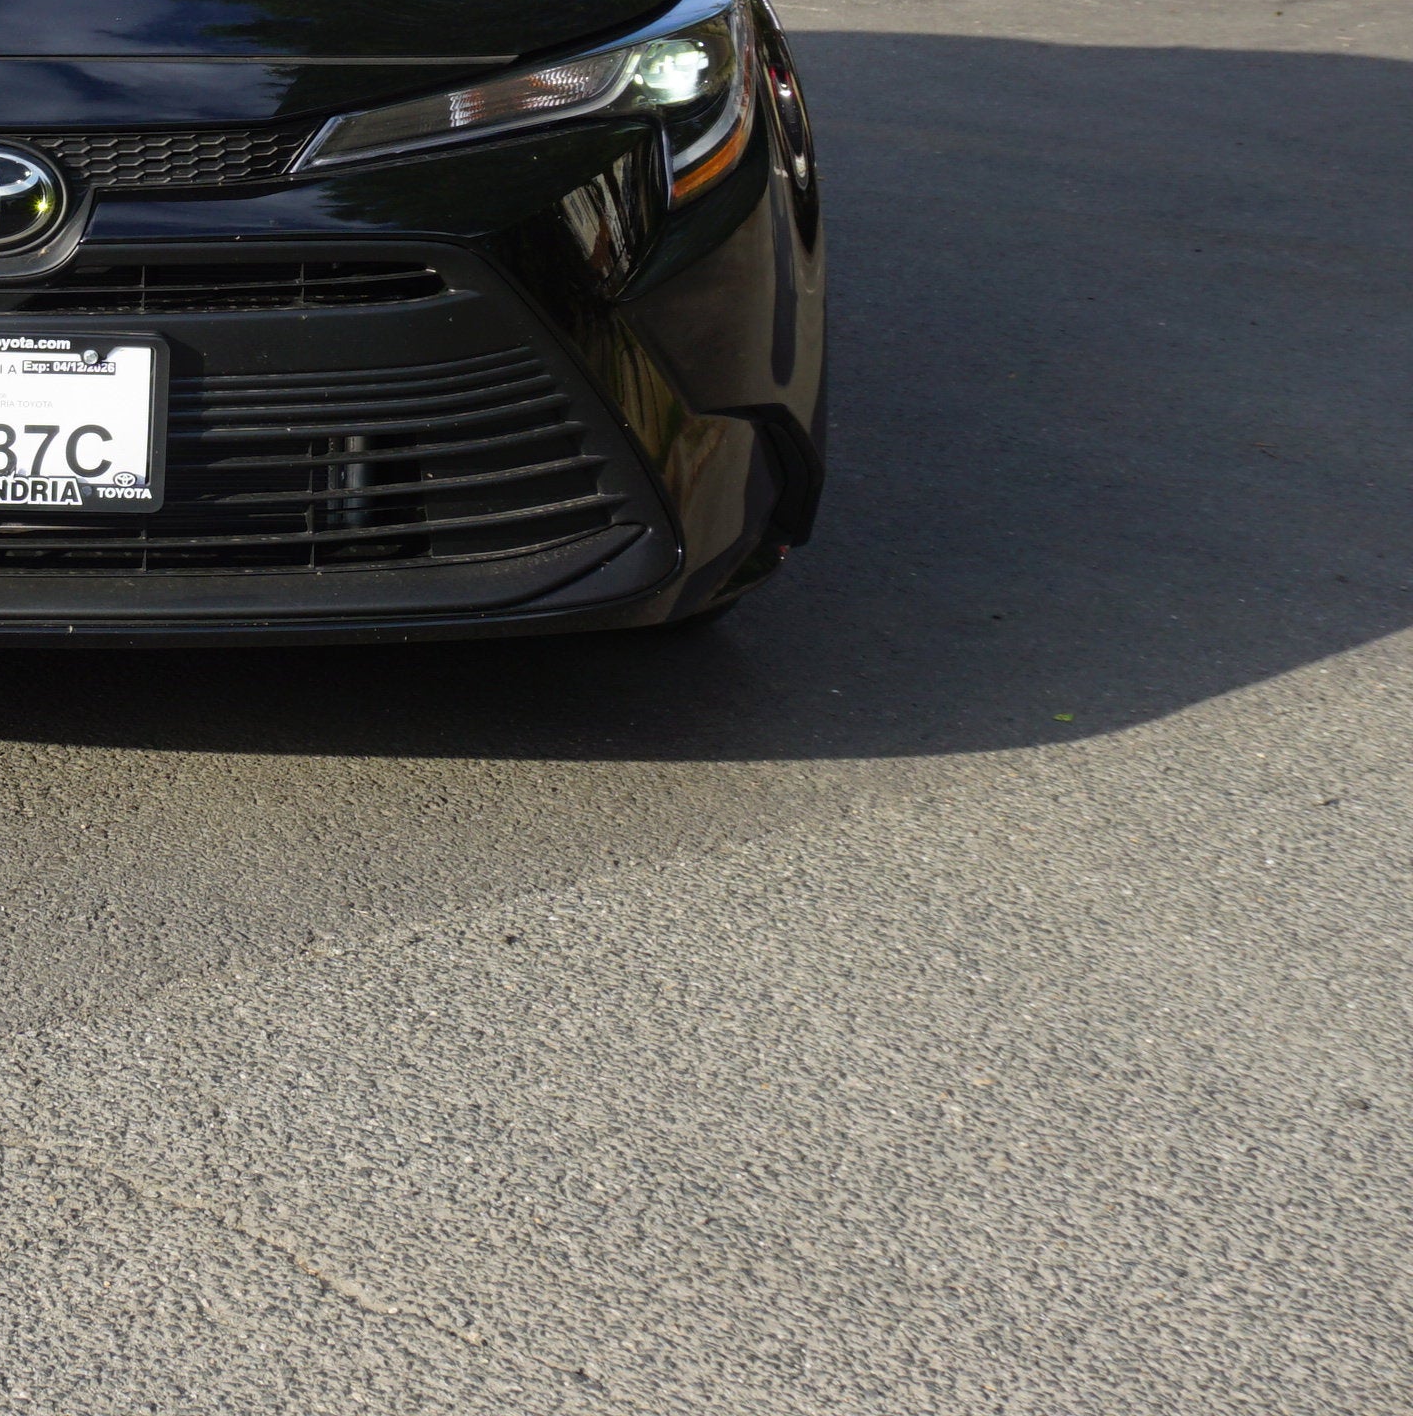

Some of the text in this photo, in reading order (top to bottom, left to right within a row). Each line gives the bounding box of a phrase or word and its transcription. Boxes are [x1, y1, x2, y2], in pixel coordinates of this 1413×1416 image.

[23, 361, 50, 373] Exp:
[17, 400, 53, 408] TOYOTA
[96, 487, 153, 499] TOYOTA
